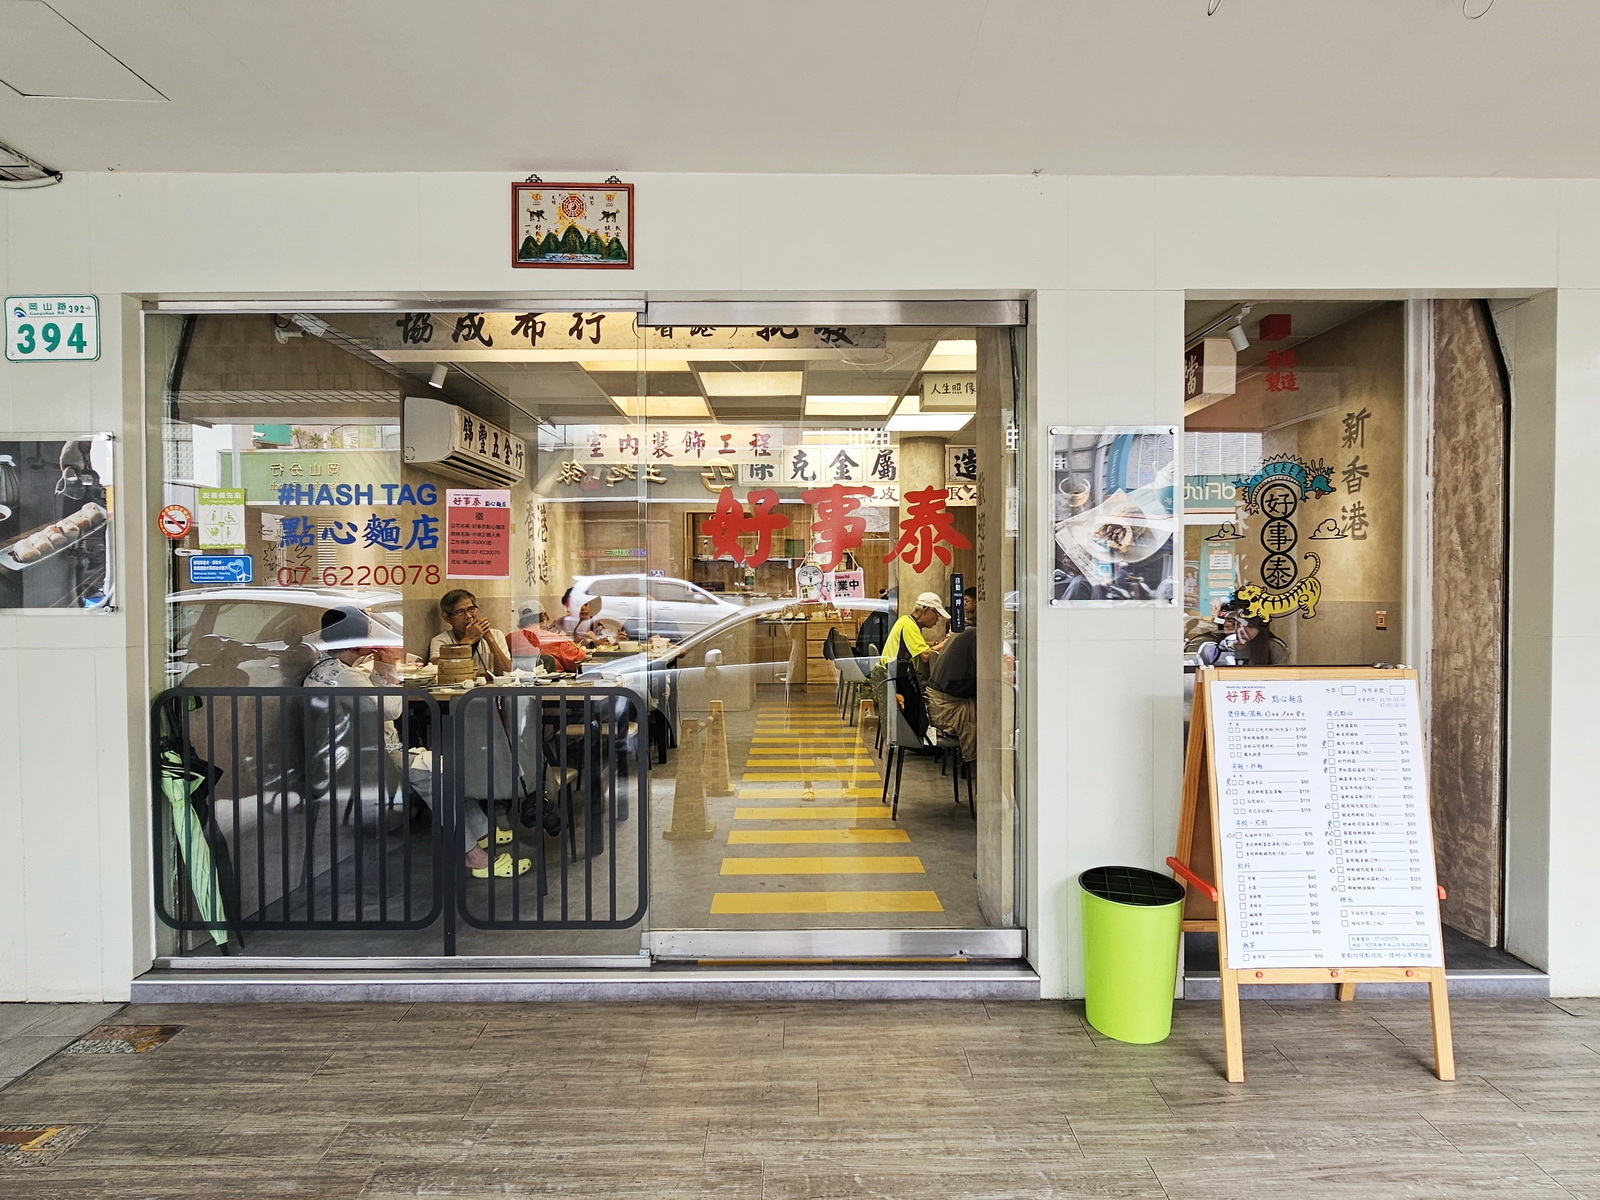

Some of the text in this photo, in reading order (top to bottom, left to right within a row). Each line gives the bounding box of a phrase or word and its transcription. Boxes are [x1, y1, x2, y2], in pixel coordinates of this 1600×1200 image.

[28, 302, 85, 314] 岡山路 392
[17, 322, 87, 354] 394
[396, 312, 606, 347] 協成布行
[1266, 350, 1299, 369] 香港
[930, 382, 976, 395] 人生照像
[1265, 372, 1300, 393] 製造
[586, 431, 773, 459] 室內裝飾工程
[954, 448, 977, 482] 造
[1341, 407, 1371, 542] 新香港
[276, 484, 373, 506] #HASH
[380, 484, 438, 506] TAG
[453, 497, 482, 507] 好事泰
[280, 513, 440, 551] 點心麵店
[701, 485, 973, 574] 好事泰
[1264, 493, 1295, 587] 好事泰
[277, 565, 441, 588] 07-6220078
[1226, 690, 1303, 704] 好事泰 點心麵店
